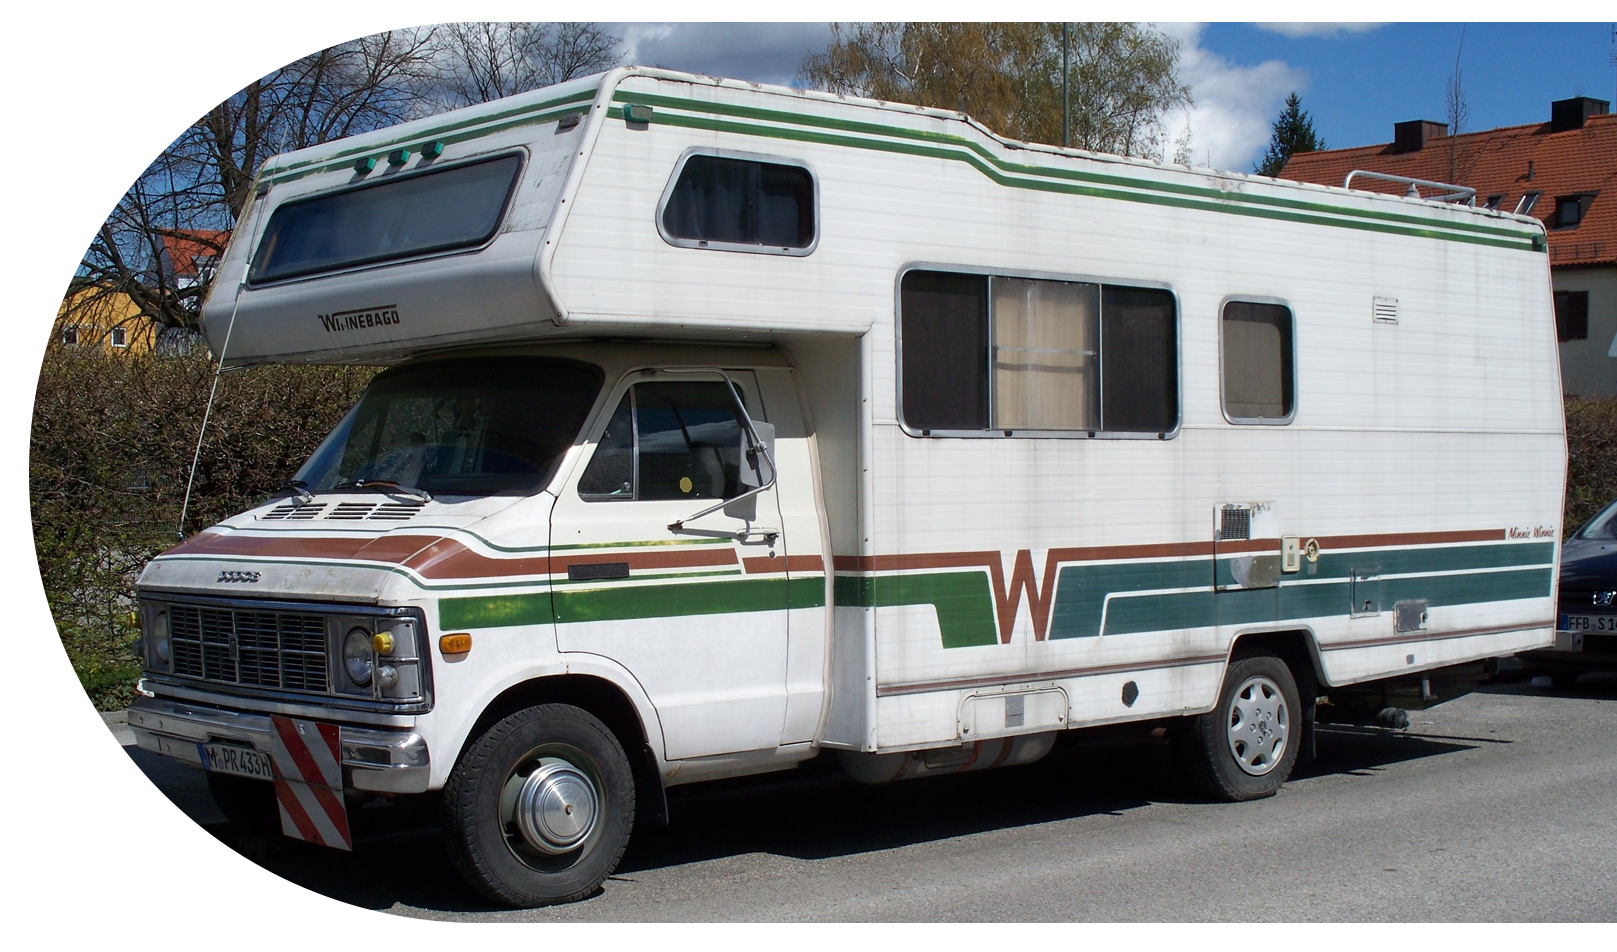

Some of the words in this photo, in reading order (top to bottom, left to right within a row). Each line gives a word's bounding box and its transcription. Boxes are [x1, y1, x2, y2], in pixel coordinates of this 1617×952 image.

[1508, 526, 1531, 540] Minnie
[1533, 525, 1555, 539] Winnie
[1569, 616, 1590, 630] FFB
[1597, 617, 1605, 631] S
[205, 746, 218, 768] M
[222, 747, 240, 772] PR
